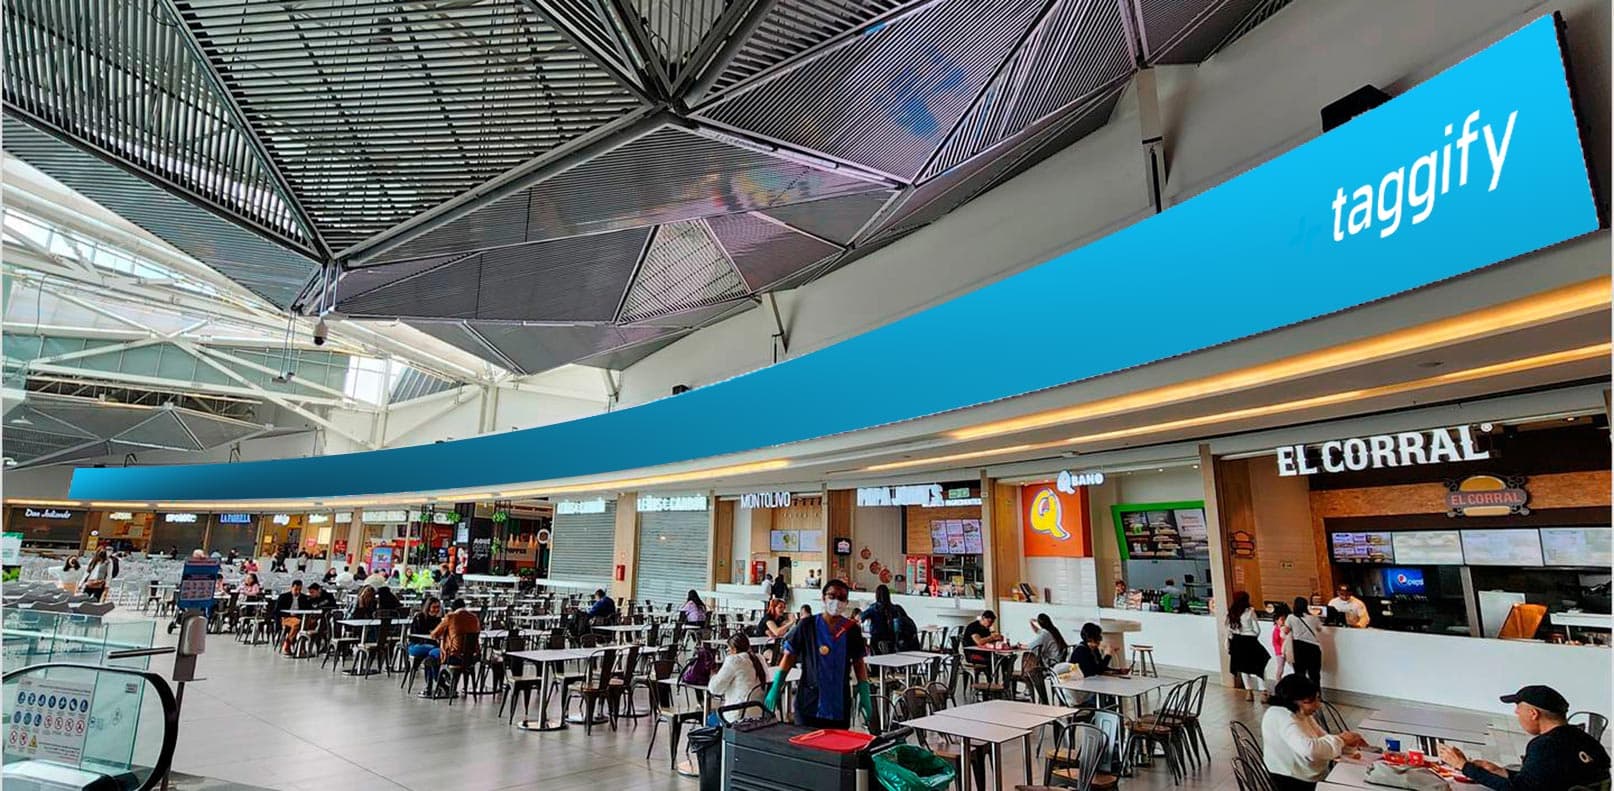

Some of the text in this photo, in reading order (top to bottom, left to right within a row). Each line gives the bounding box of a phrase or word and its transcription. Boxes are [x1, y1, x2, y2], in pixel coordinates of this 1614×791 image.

[1331, 109, 1519, 243] taggify
[1276, 424, 1490, 476] EL CORRAL
[740, 491, 791, 509] MONTOLIVO
[1451, 491, 1521, 505] EL CORRAL
